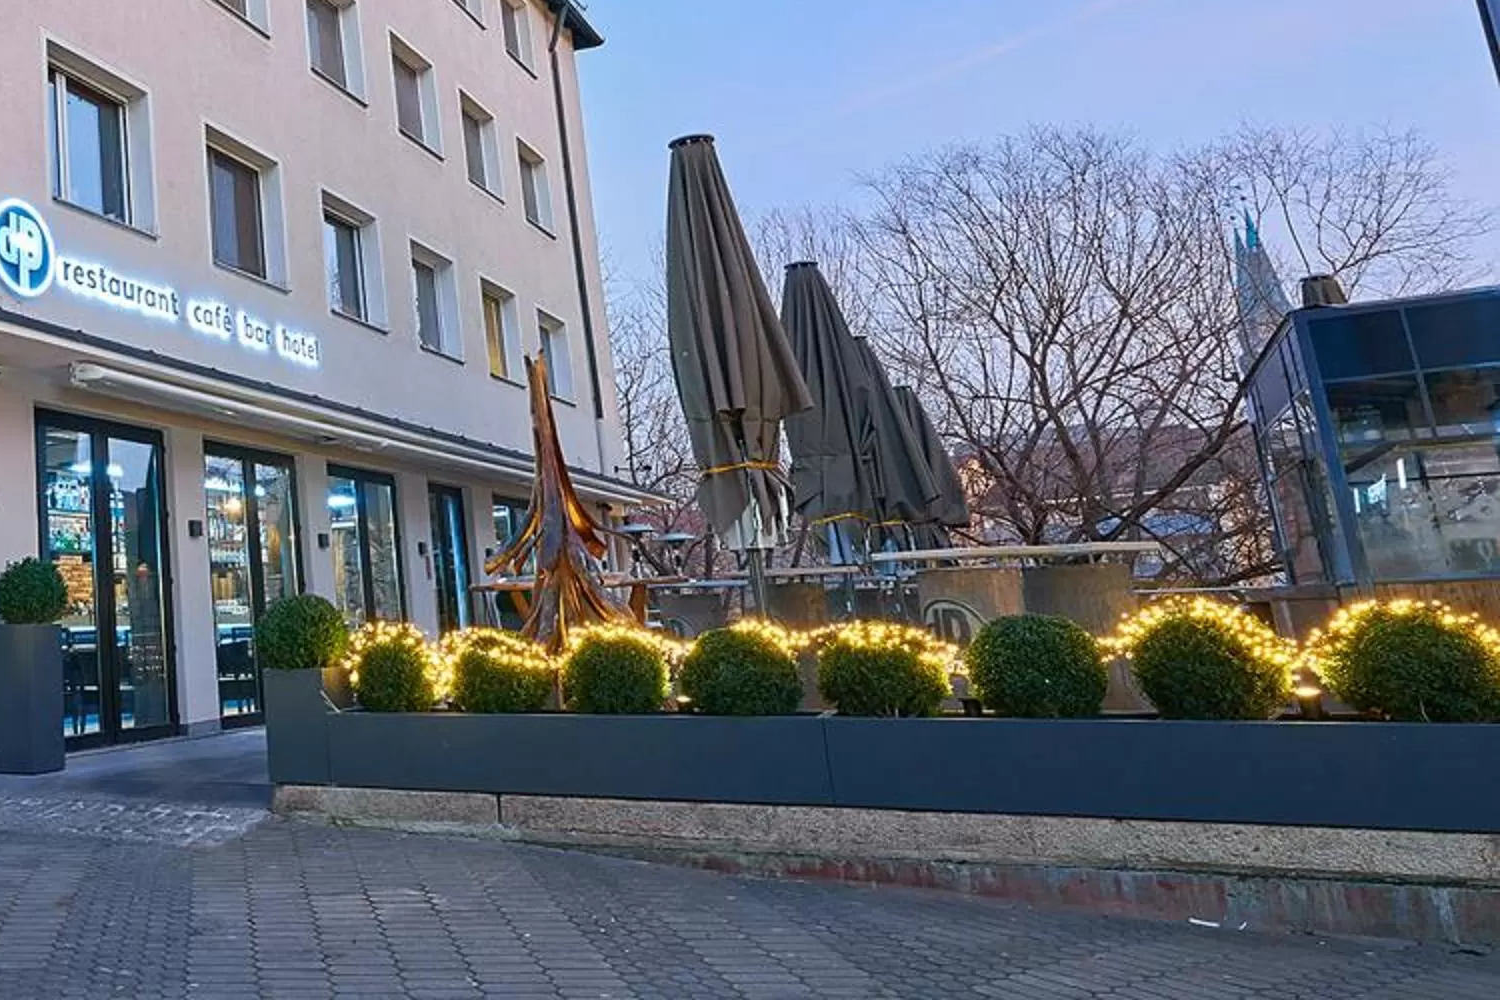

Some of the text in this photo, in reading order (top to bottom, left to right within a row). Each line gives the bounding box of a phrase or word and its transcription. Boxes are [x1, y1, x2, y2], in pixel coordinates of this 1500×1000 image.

[62, 258, 321, 361] restaurant café bar hotel
